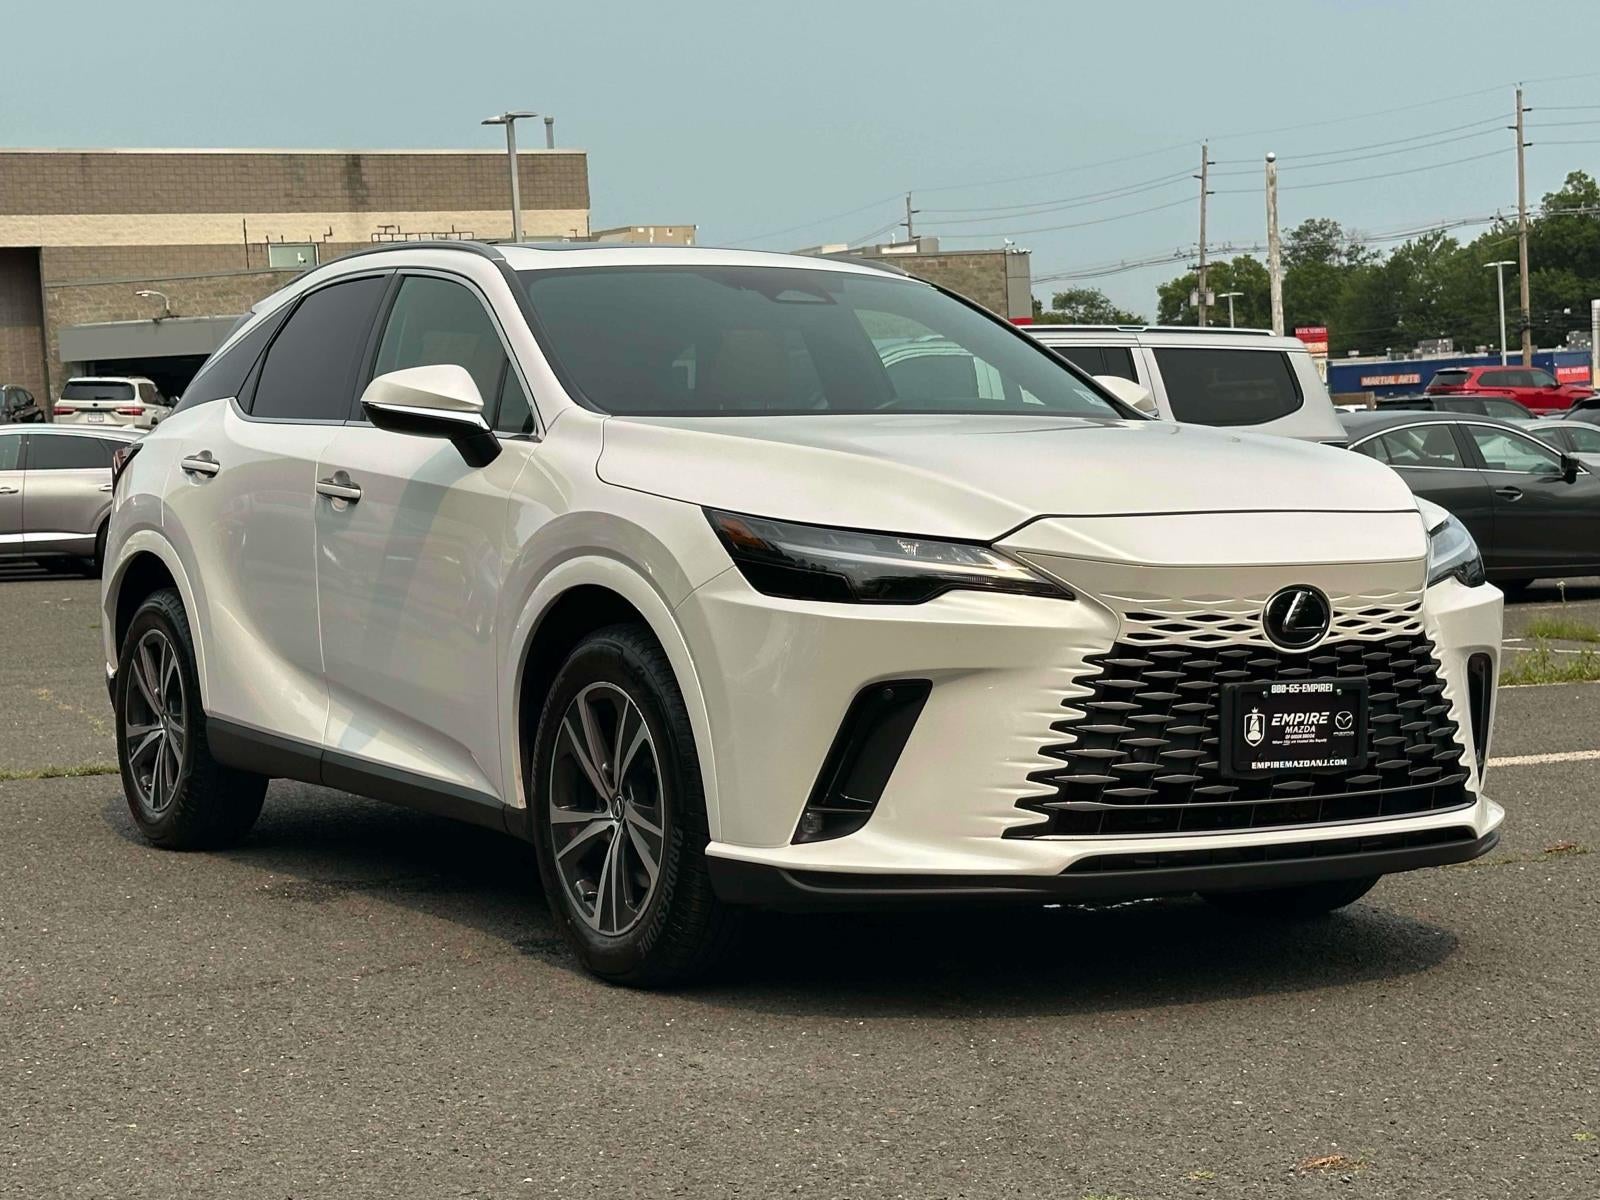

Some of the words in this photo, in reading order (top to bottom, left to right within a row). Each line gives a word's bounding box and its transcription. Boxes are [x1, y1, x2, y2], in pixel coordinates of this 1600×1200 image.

[1360, 375, 1394, 386] MARTIAL
[1398, 373, 1421, 384] ARTS
[1271, 711, 1330, 726] EMPIRE
[1284, 725, 1316, 733] MAZDA
[1251, 759, 1347, 769] EMPIREMAZDANJ.COM
